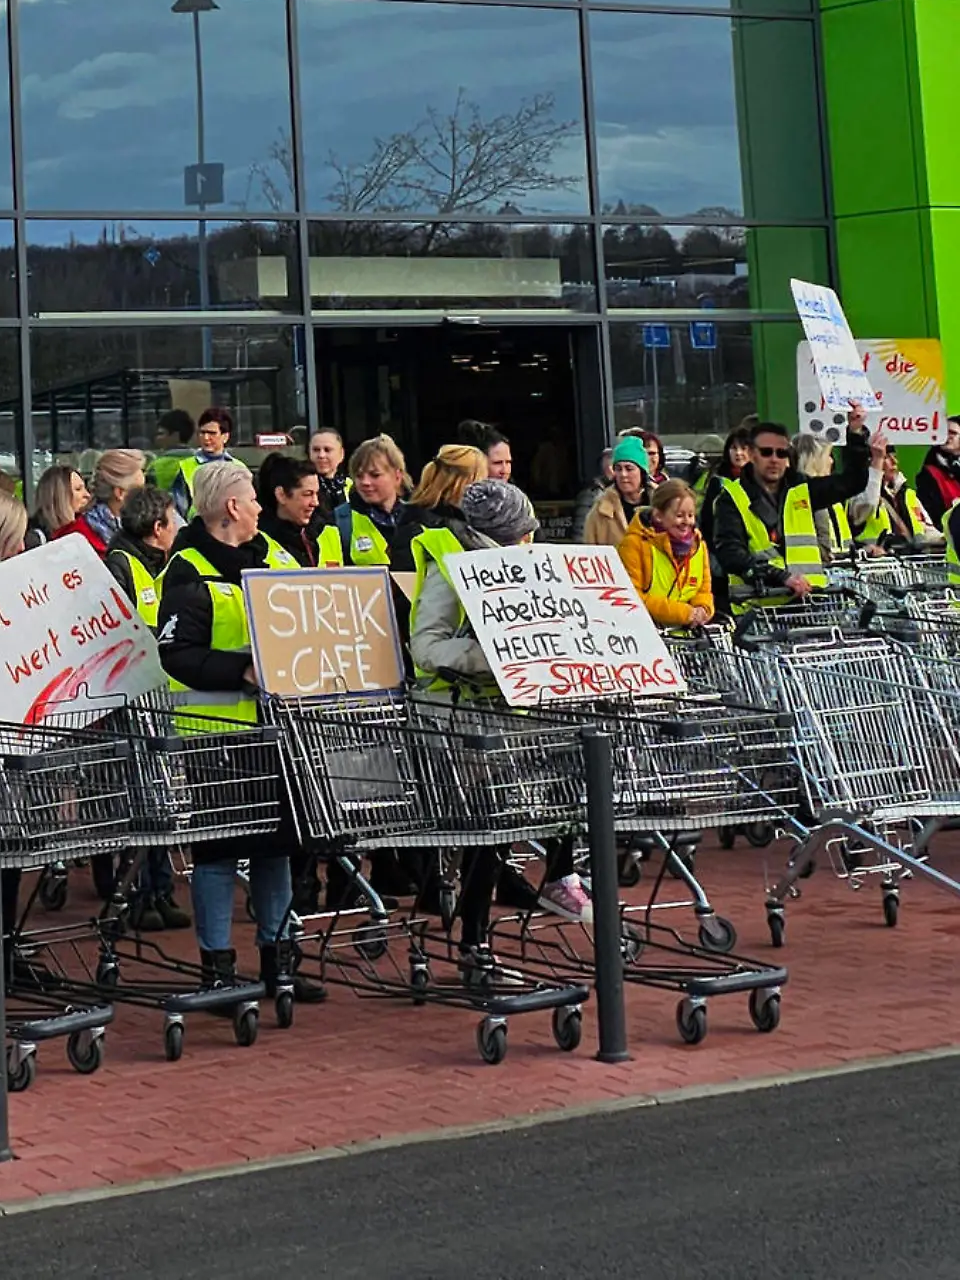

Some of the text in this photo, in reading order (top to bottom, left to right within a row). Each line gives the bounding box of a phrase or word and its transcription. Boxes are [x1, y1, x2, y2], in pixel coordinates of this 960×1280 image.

[886, 353, 917, 373] die
[62, 569, 83, 590] es
[460, 549, 616, 591] Heute ist KEIN
[267, 583, 387, 637] STREIK
[481, 589, 589, 628] Arbeitstag
[493, 621, 638, 662] HEUTE ist ein
[548, 658, 677, 696] STREIKTAG
